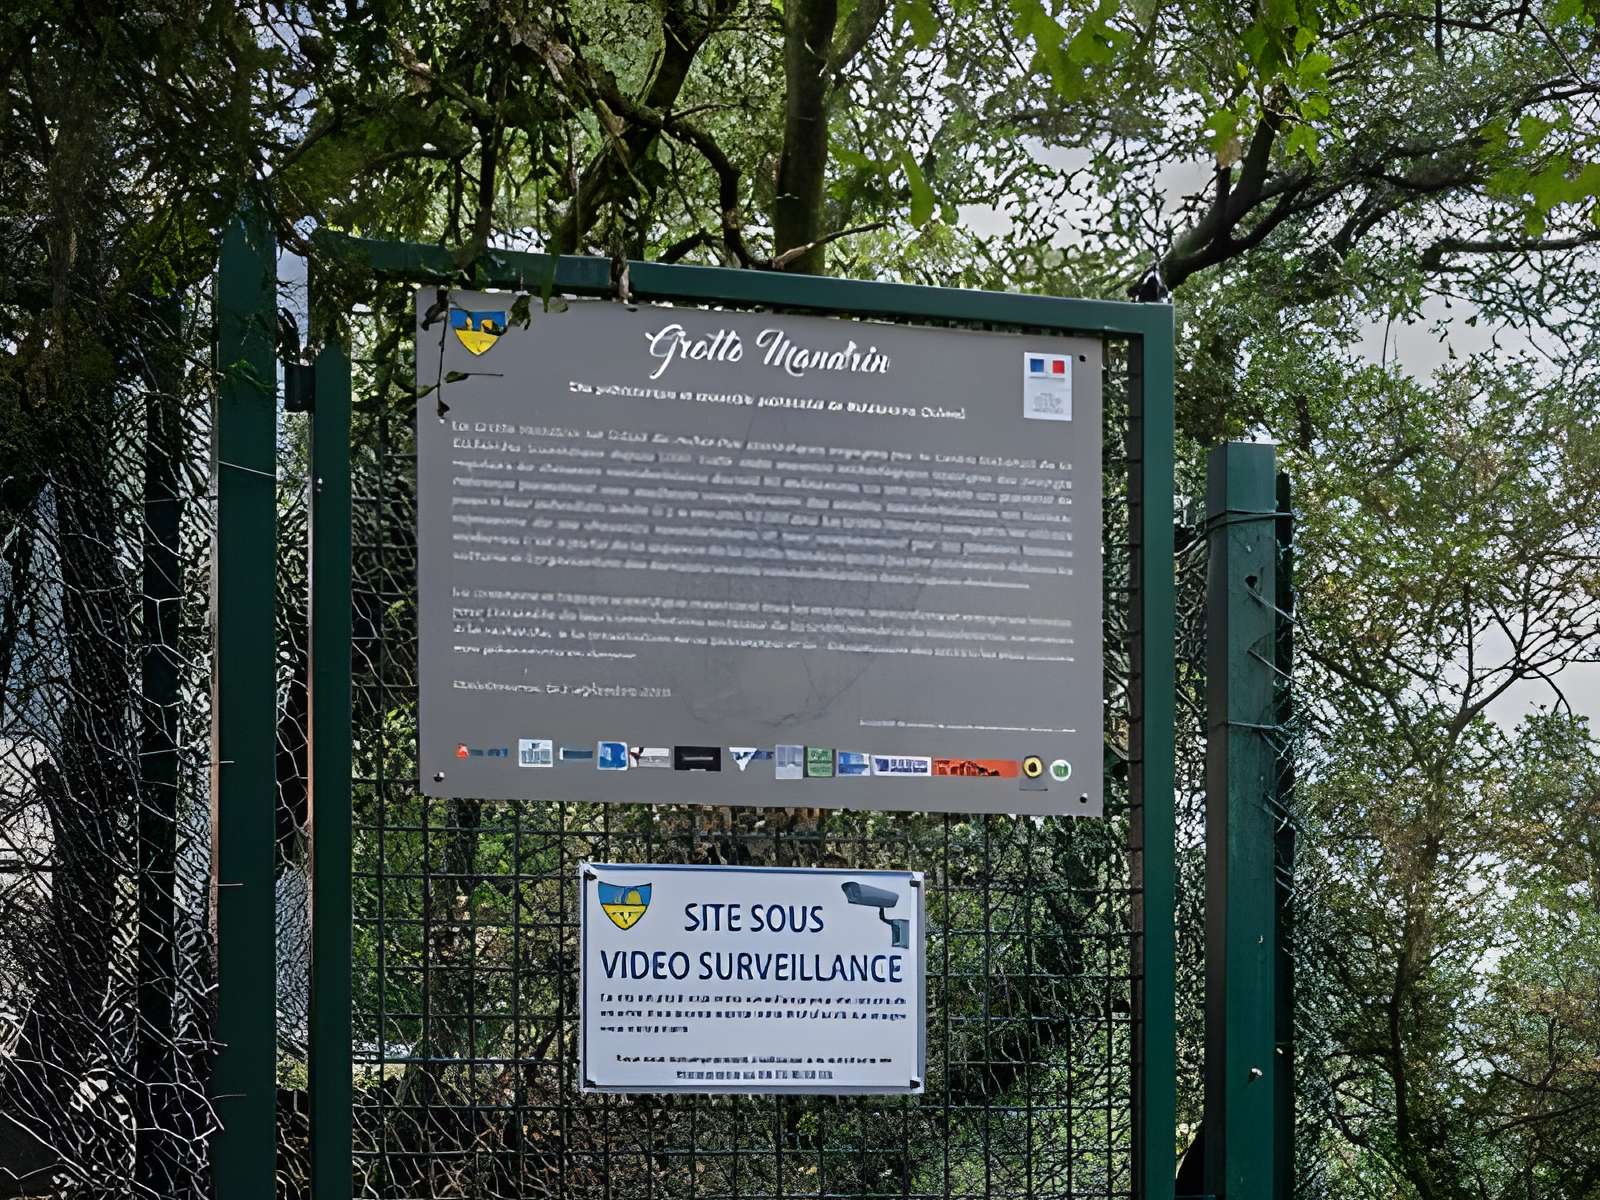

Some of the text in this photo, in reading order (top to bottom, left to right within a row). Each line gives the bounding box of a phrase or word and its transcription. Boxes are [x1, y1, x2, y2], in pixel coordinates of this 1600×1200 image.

[756, 329, 890, 377] Mandrin
[684, 903, 824, 933] SITE SOUS
[600, 950, 903, 983] VIDEO SURVEILLANCE
